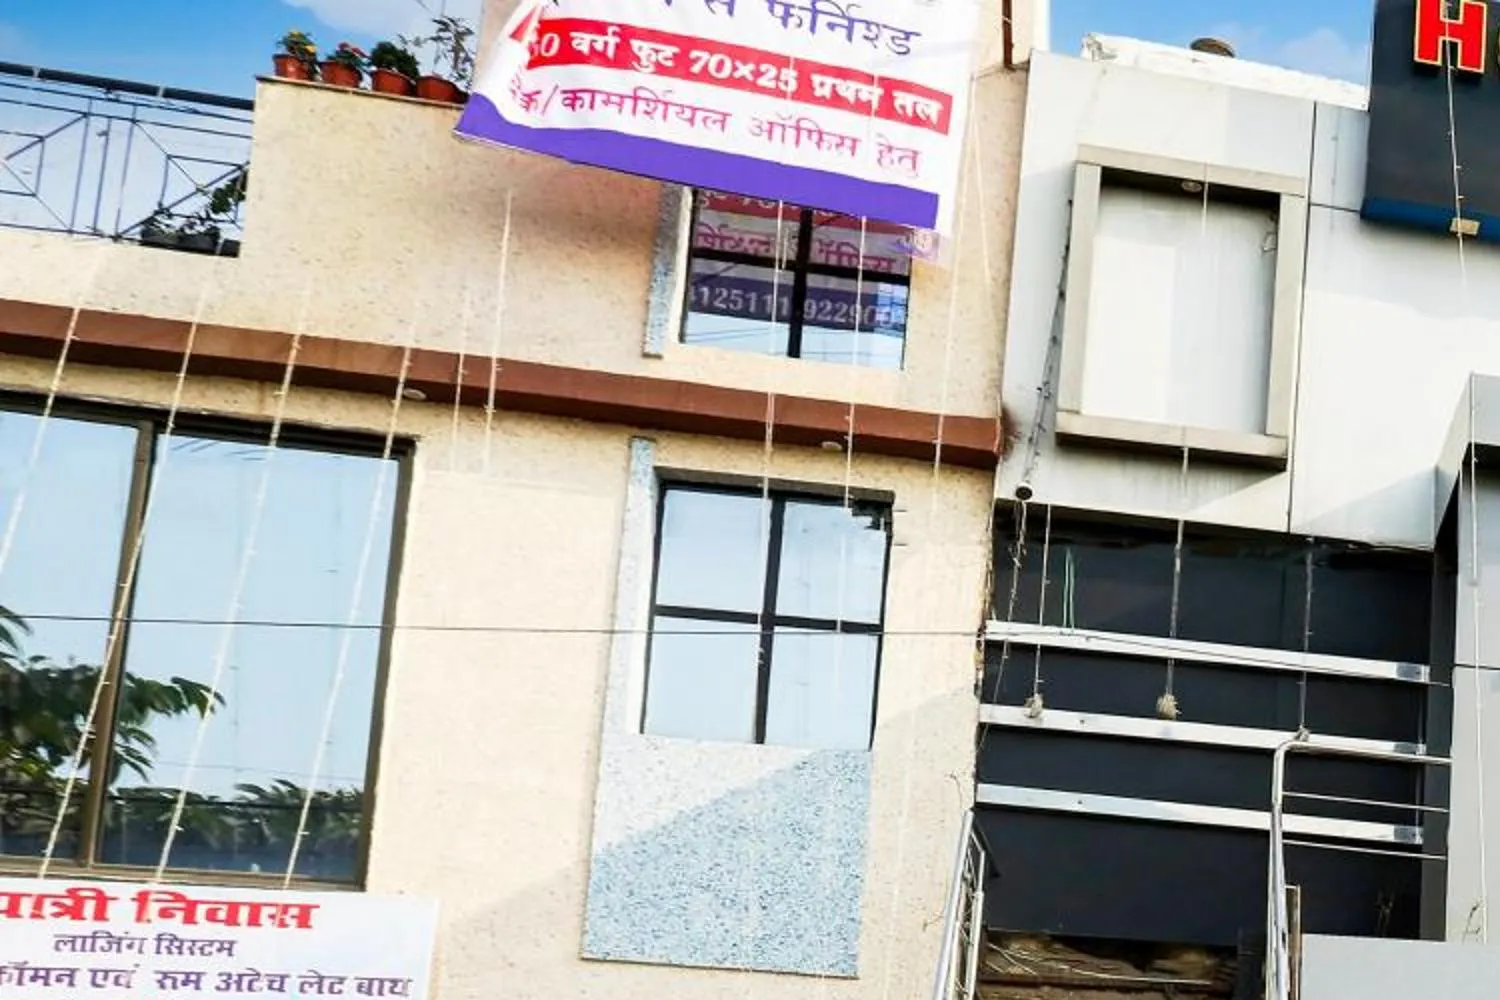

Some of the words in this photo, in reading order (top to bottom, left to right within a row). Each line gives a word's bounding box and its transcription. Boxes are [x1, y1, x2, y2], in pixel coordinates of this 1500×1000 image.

[570, 26, 620, 59] वर्ग
[630, 38, 678, 73] फुट
[811, 73, 884, 110] प्रथम
[893, 91, 943, 124] तल
[130, 889, 320, 928] निवास
[154, 933, 236, 957] सिस्टम
[88, 963, 140, 989] एवं
[296, 969, 348, 995] लेट
